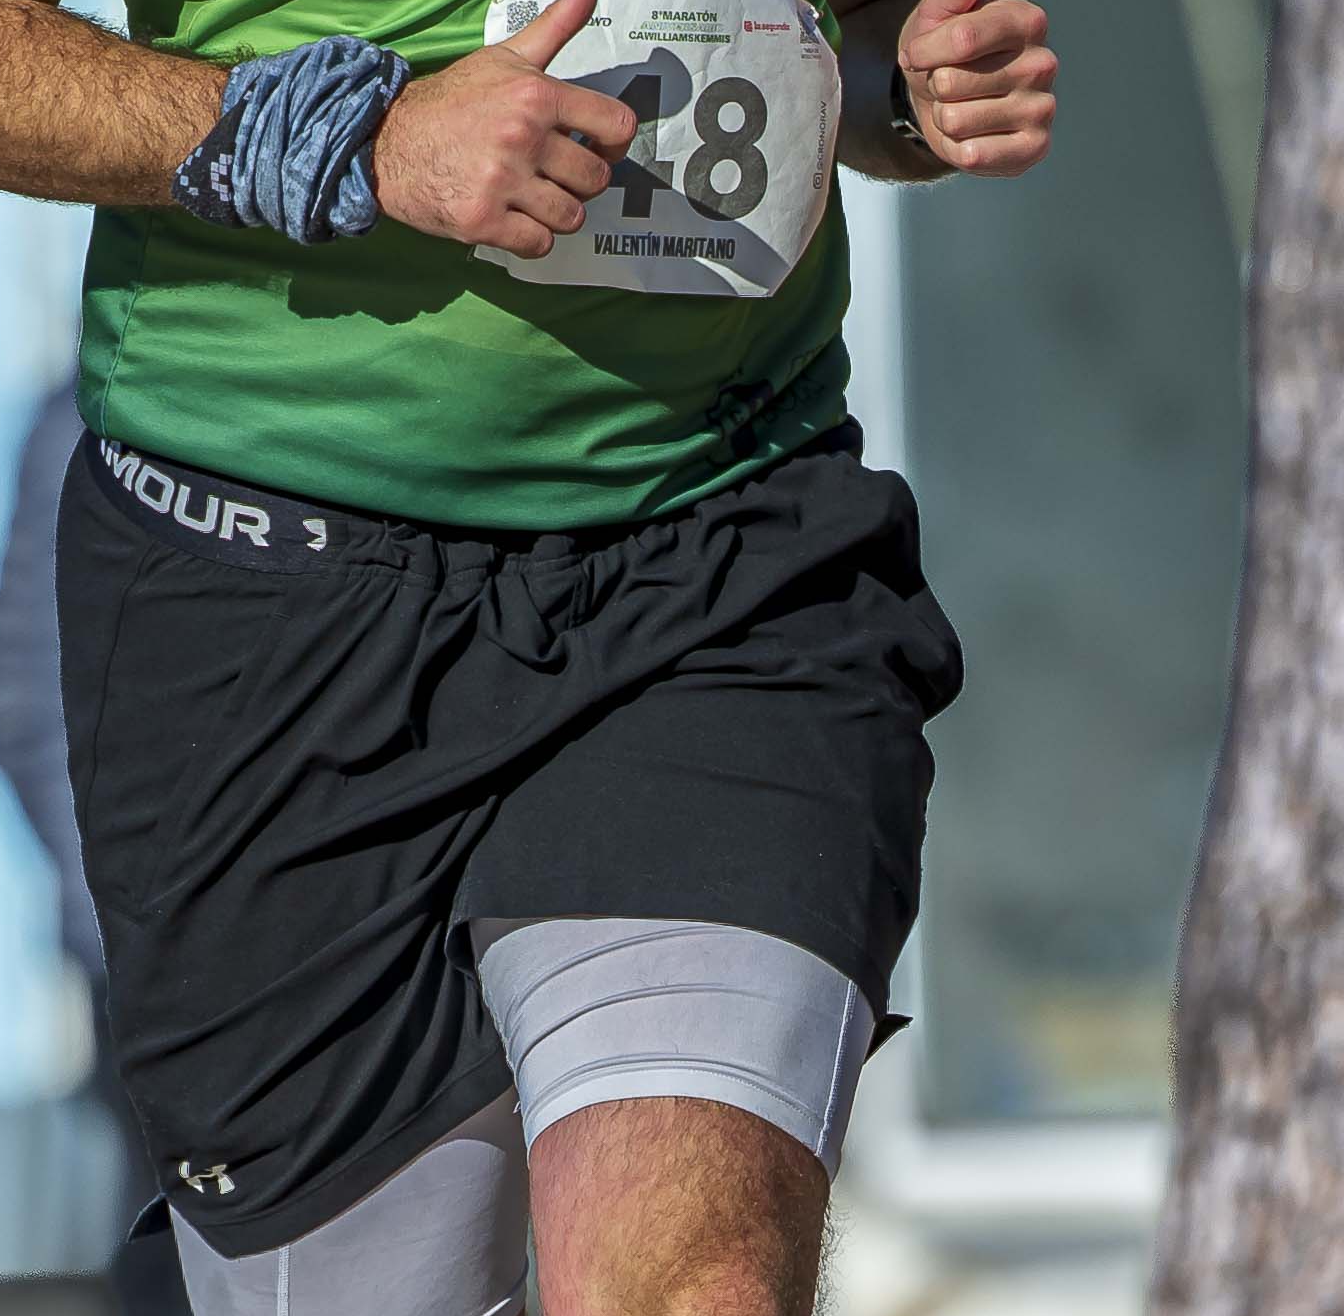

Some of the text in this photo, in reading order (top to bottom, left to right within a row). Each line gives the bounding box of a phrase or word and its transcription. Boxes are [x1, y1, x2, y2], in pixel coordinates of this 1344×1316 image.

[629, 31, 731, 44] CAWILLIAMSKEMMIS
[594, 231, 736, 260] VALENTÍN MARITANO
[101, 439, 270, 547] MOUR
